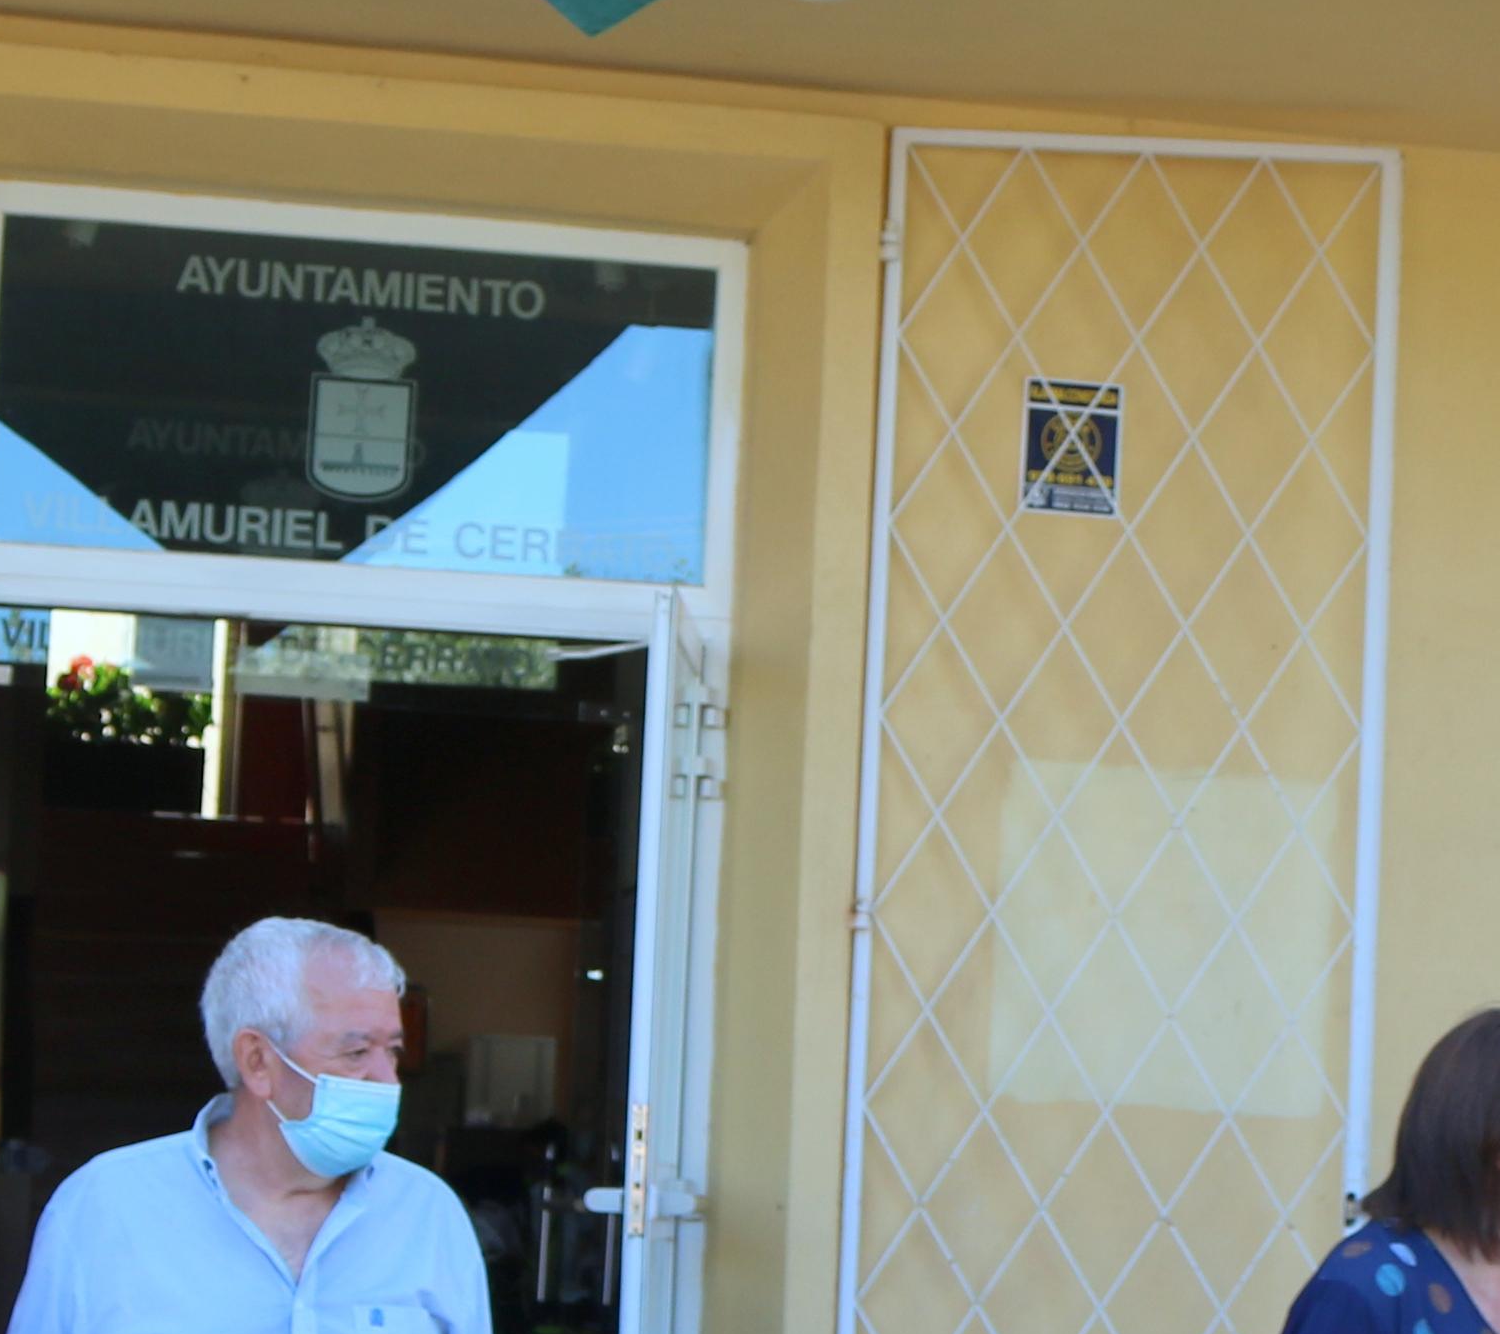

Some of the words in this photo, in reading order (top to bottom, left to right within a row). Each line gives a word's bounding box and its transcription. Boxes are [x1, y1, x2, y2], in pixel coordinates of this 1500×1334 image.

[176, 254, 546, 320] AYUNTAMIENTO
[23, 491, 344, 551] VILLAMURIEL
[366, 515, 429, 557] DE
